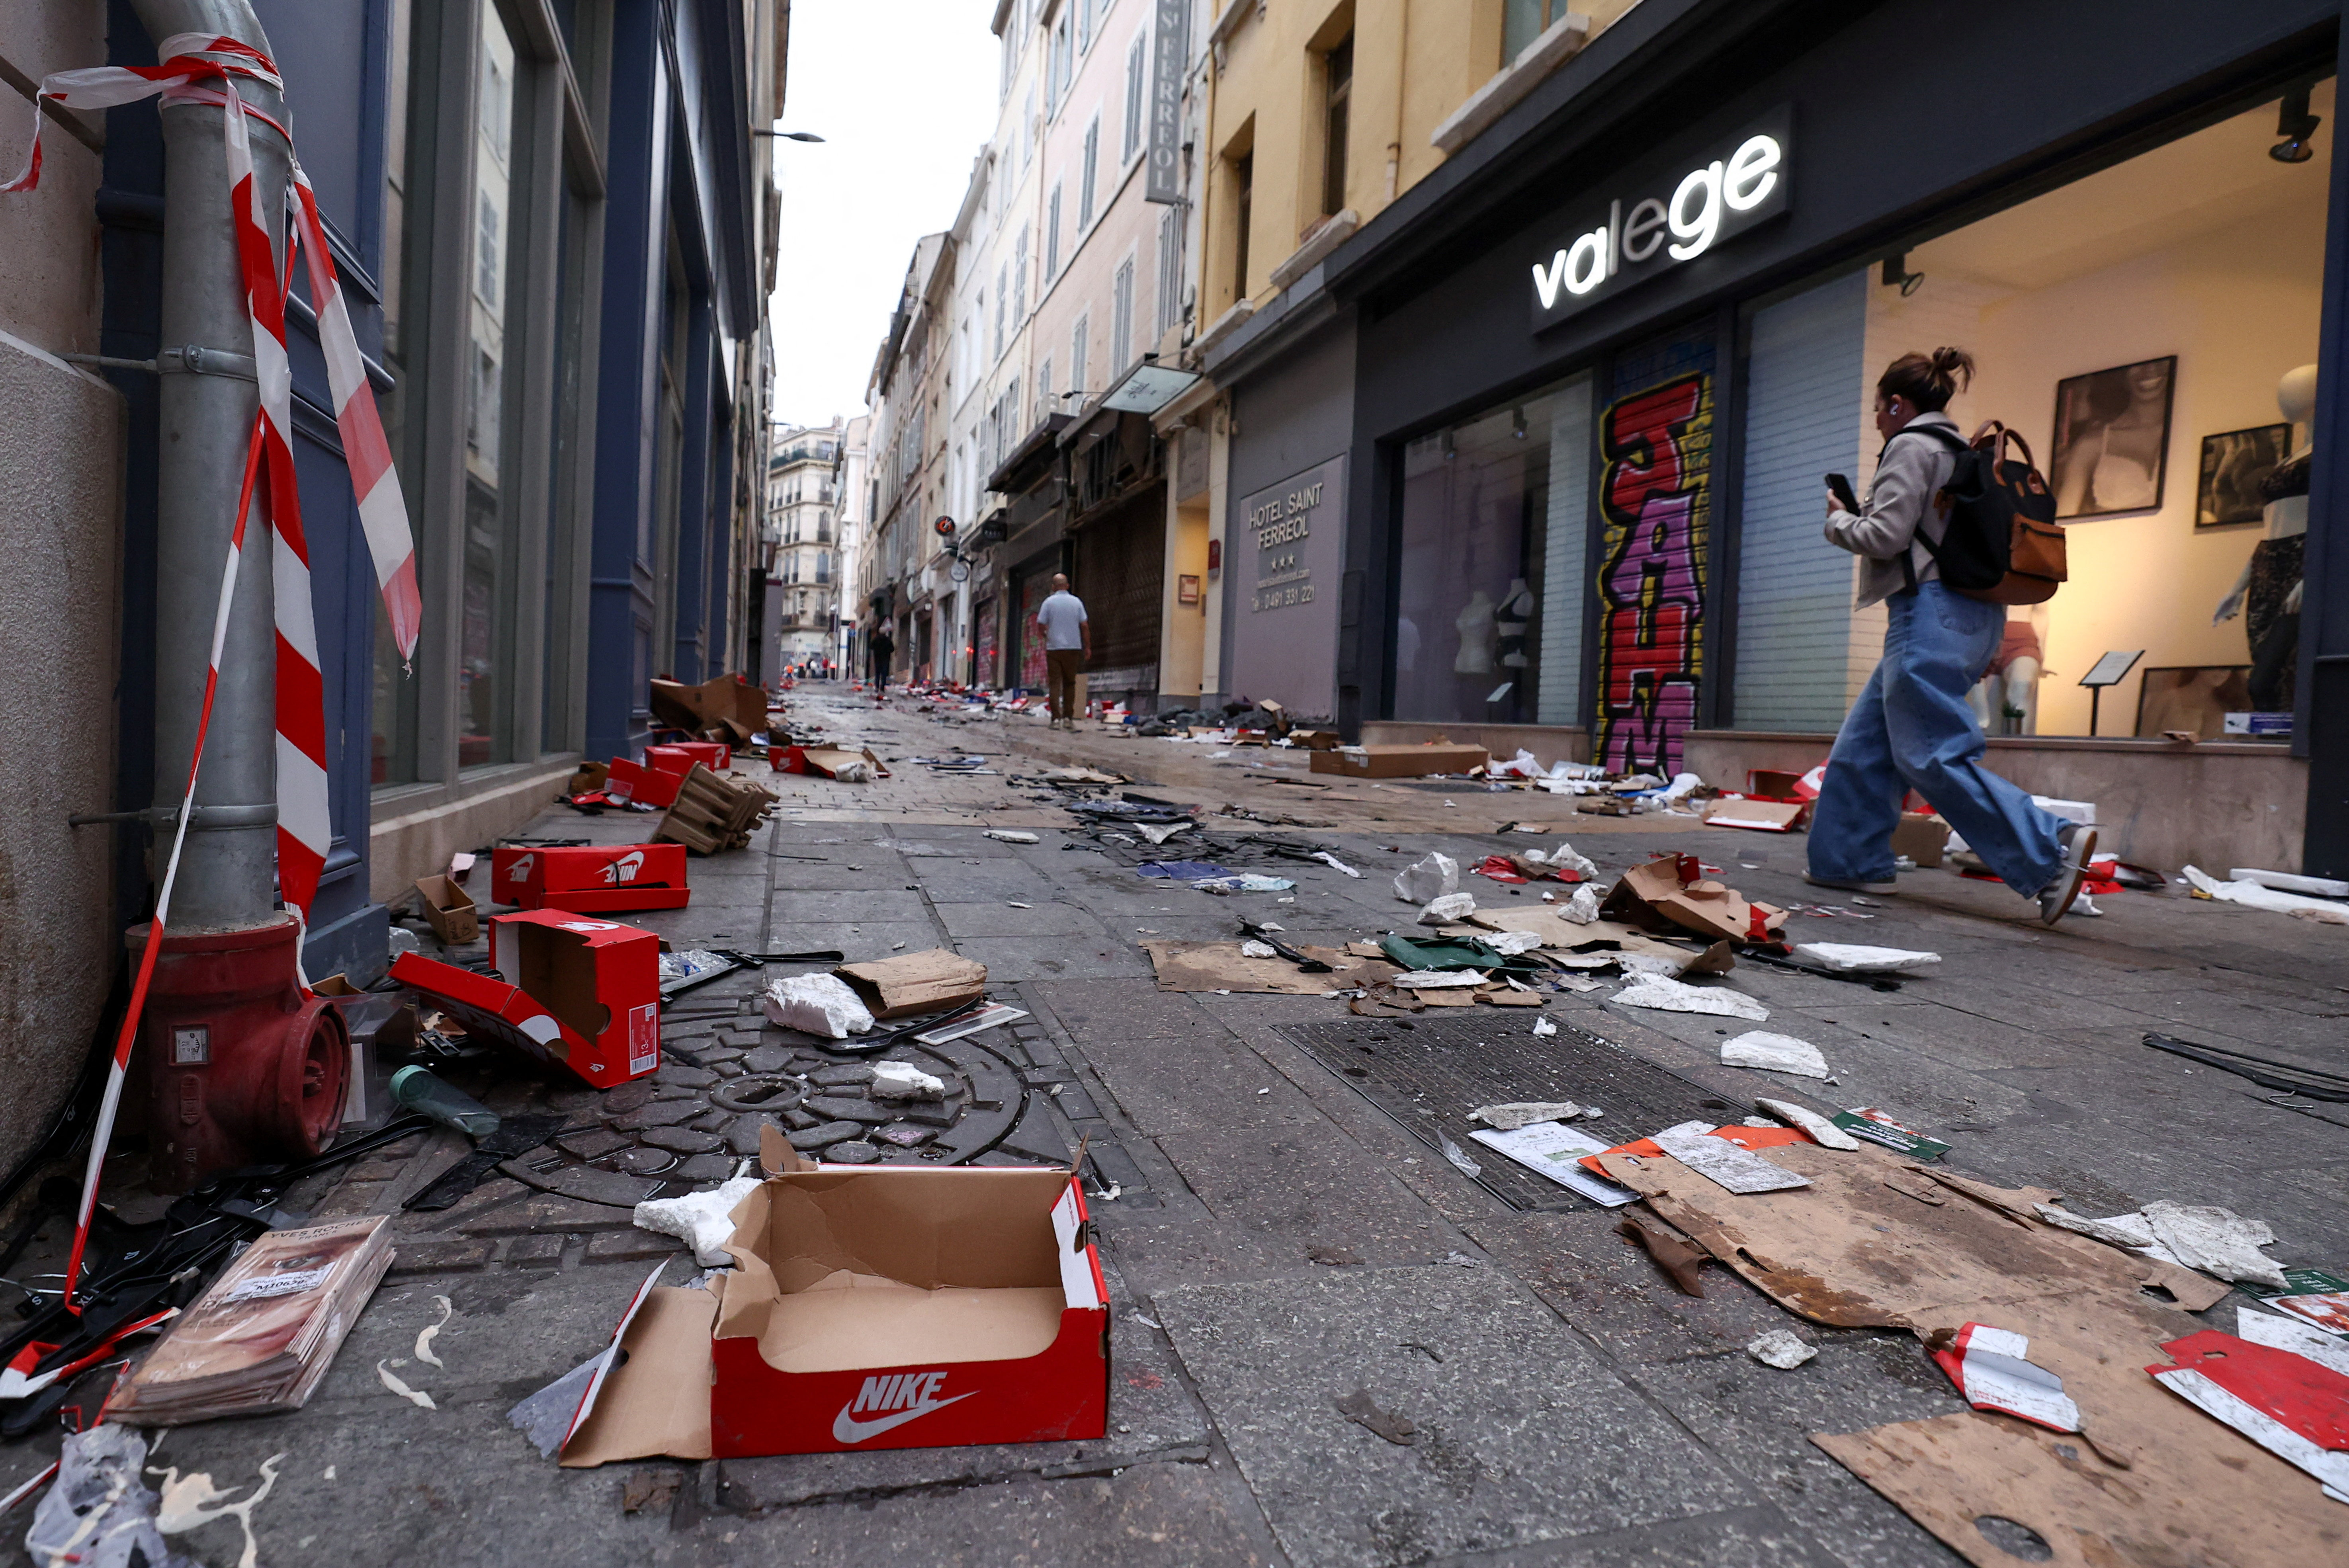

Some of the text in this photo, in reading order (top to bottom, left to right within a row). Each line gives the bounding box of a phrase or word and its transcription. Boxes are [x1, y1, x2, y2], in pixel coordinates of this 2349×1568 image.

[1154, 36, 1177, 190] FERREOL
[1532, 134, 1781, 310] valege
[1249, 482, 1323, 531] HOTEL SAINT
[1258, 515, 1309, 550] FERREOL
[1285, 588, 1299, 605] 331
[1302, 584, 1316, 602] 221
[604, 864, 638, 883] NIKE
[271, 1218, 375, 1242] YVES ROCHER
[298, 1230, 337, 1241] FRANCE
[31, 1295, 43, 1306] S
[76, 1294, 94, 1306] XL
[852, 1371, 948, 1414] NIKE
